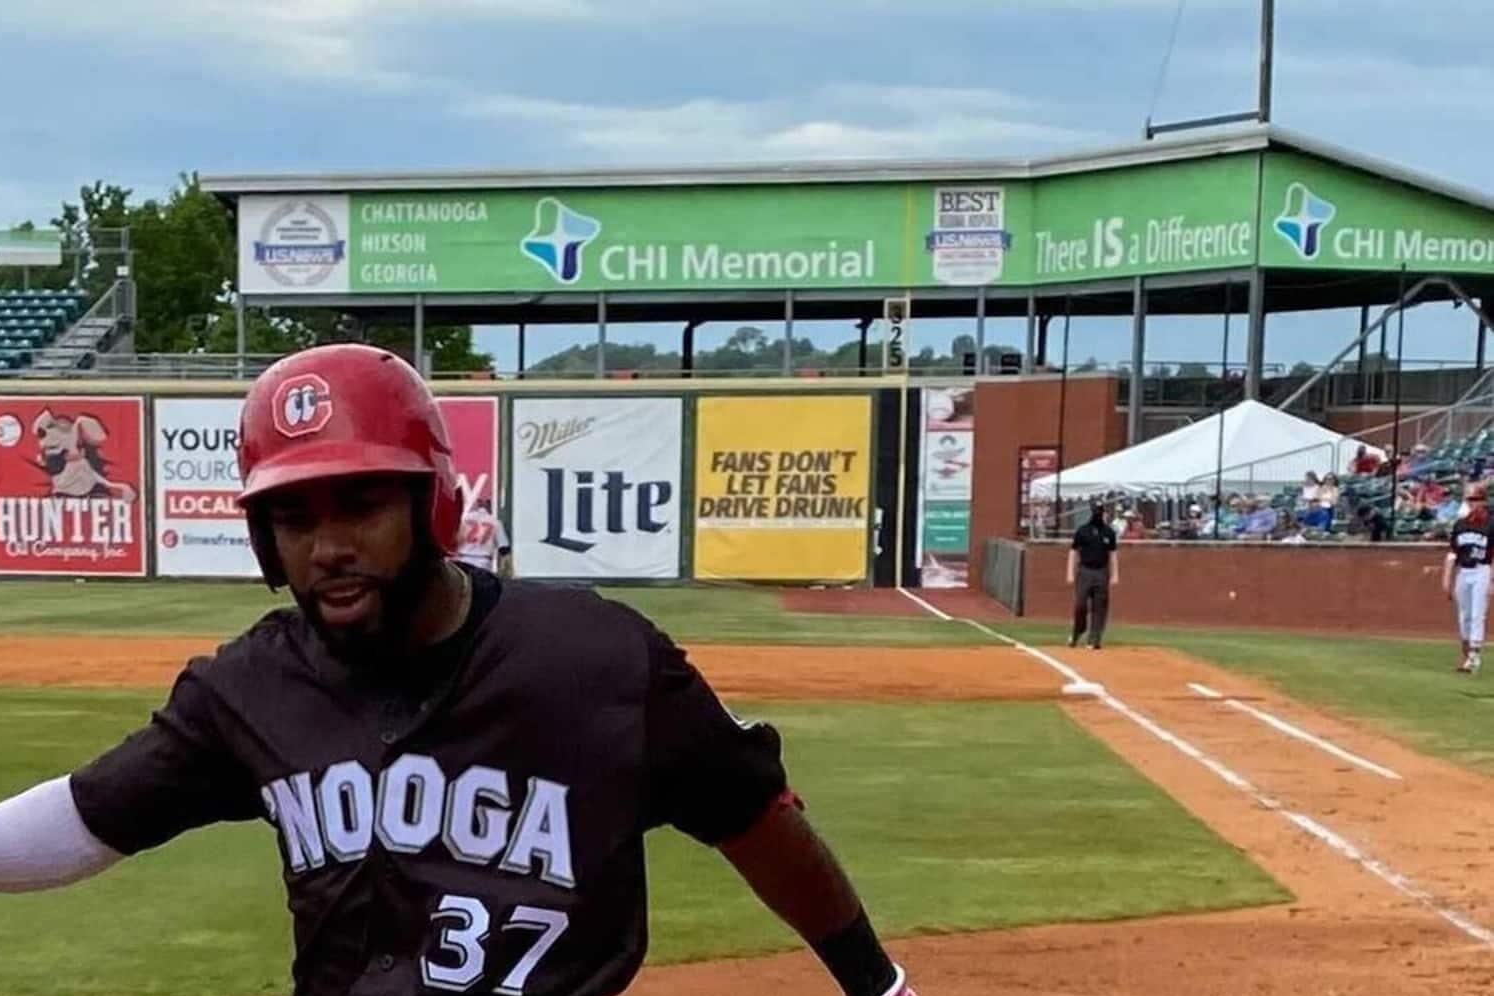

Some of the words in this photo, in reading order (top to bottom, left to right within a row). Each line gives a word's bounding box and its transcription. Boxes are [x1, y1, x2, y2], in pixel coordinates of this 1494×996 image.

[361, 202, 489, 223] CHATTANOOGA
[939, 192, 1000, 212] BEST
[361, 232, 426, 253] HIXSON
[1035, 231, 1087, 275] There
[1092, 217, 1124, 268] IS
[1128, 233, 1140, 265] a
[1145, 214, 1251, 262] Difference
[1333, 227, 1382, 259] CHI
[600, 245, 667, 282] CHI
[682, 240, 875, 281] Memorial
[361, 263, 438, 284] GEORGIA
[162, 428, 240, 451] YOUR
[517, 417, 596, 460] Miller
[163, 459, 241, 481] SOURC
[711, 451, 773, 473] FANS
[778, 450, 858, 473] DON'T
[726, 474, 771, 496] LET
[775, 474, 838, 496] FANS
[538, 467, 673, 554] Lite
[698, 497, 771, 519] DRIVE
[774, 497, 866, 519] DRUNK
[182, 533, 250, 547] timesfreep
